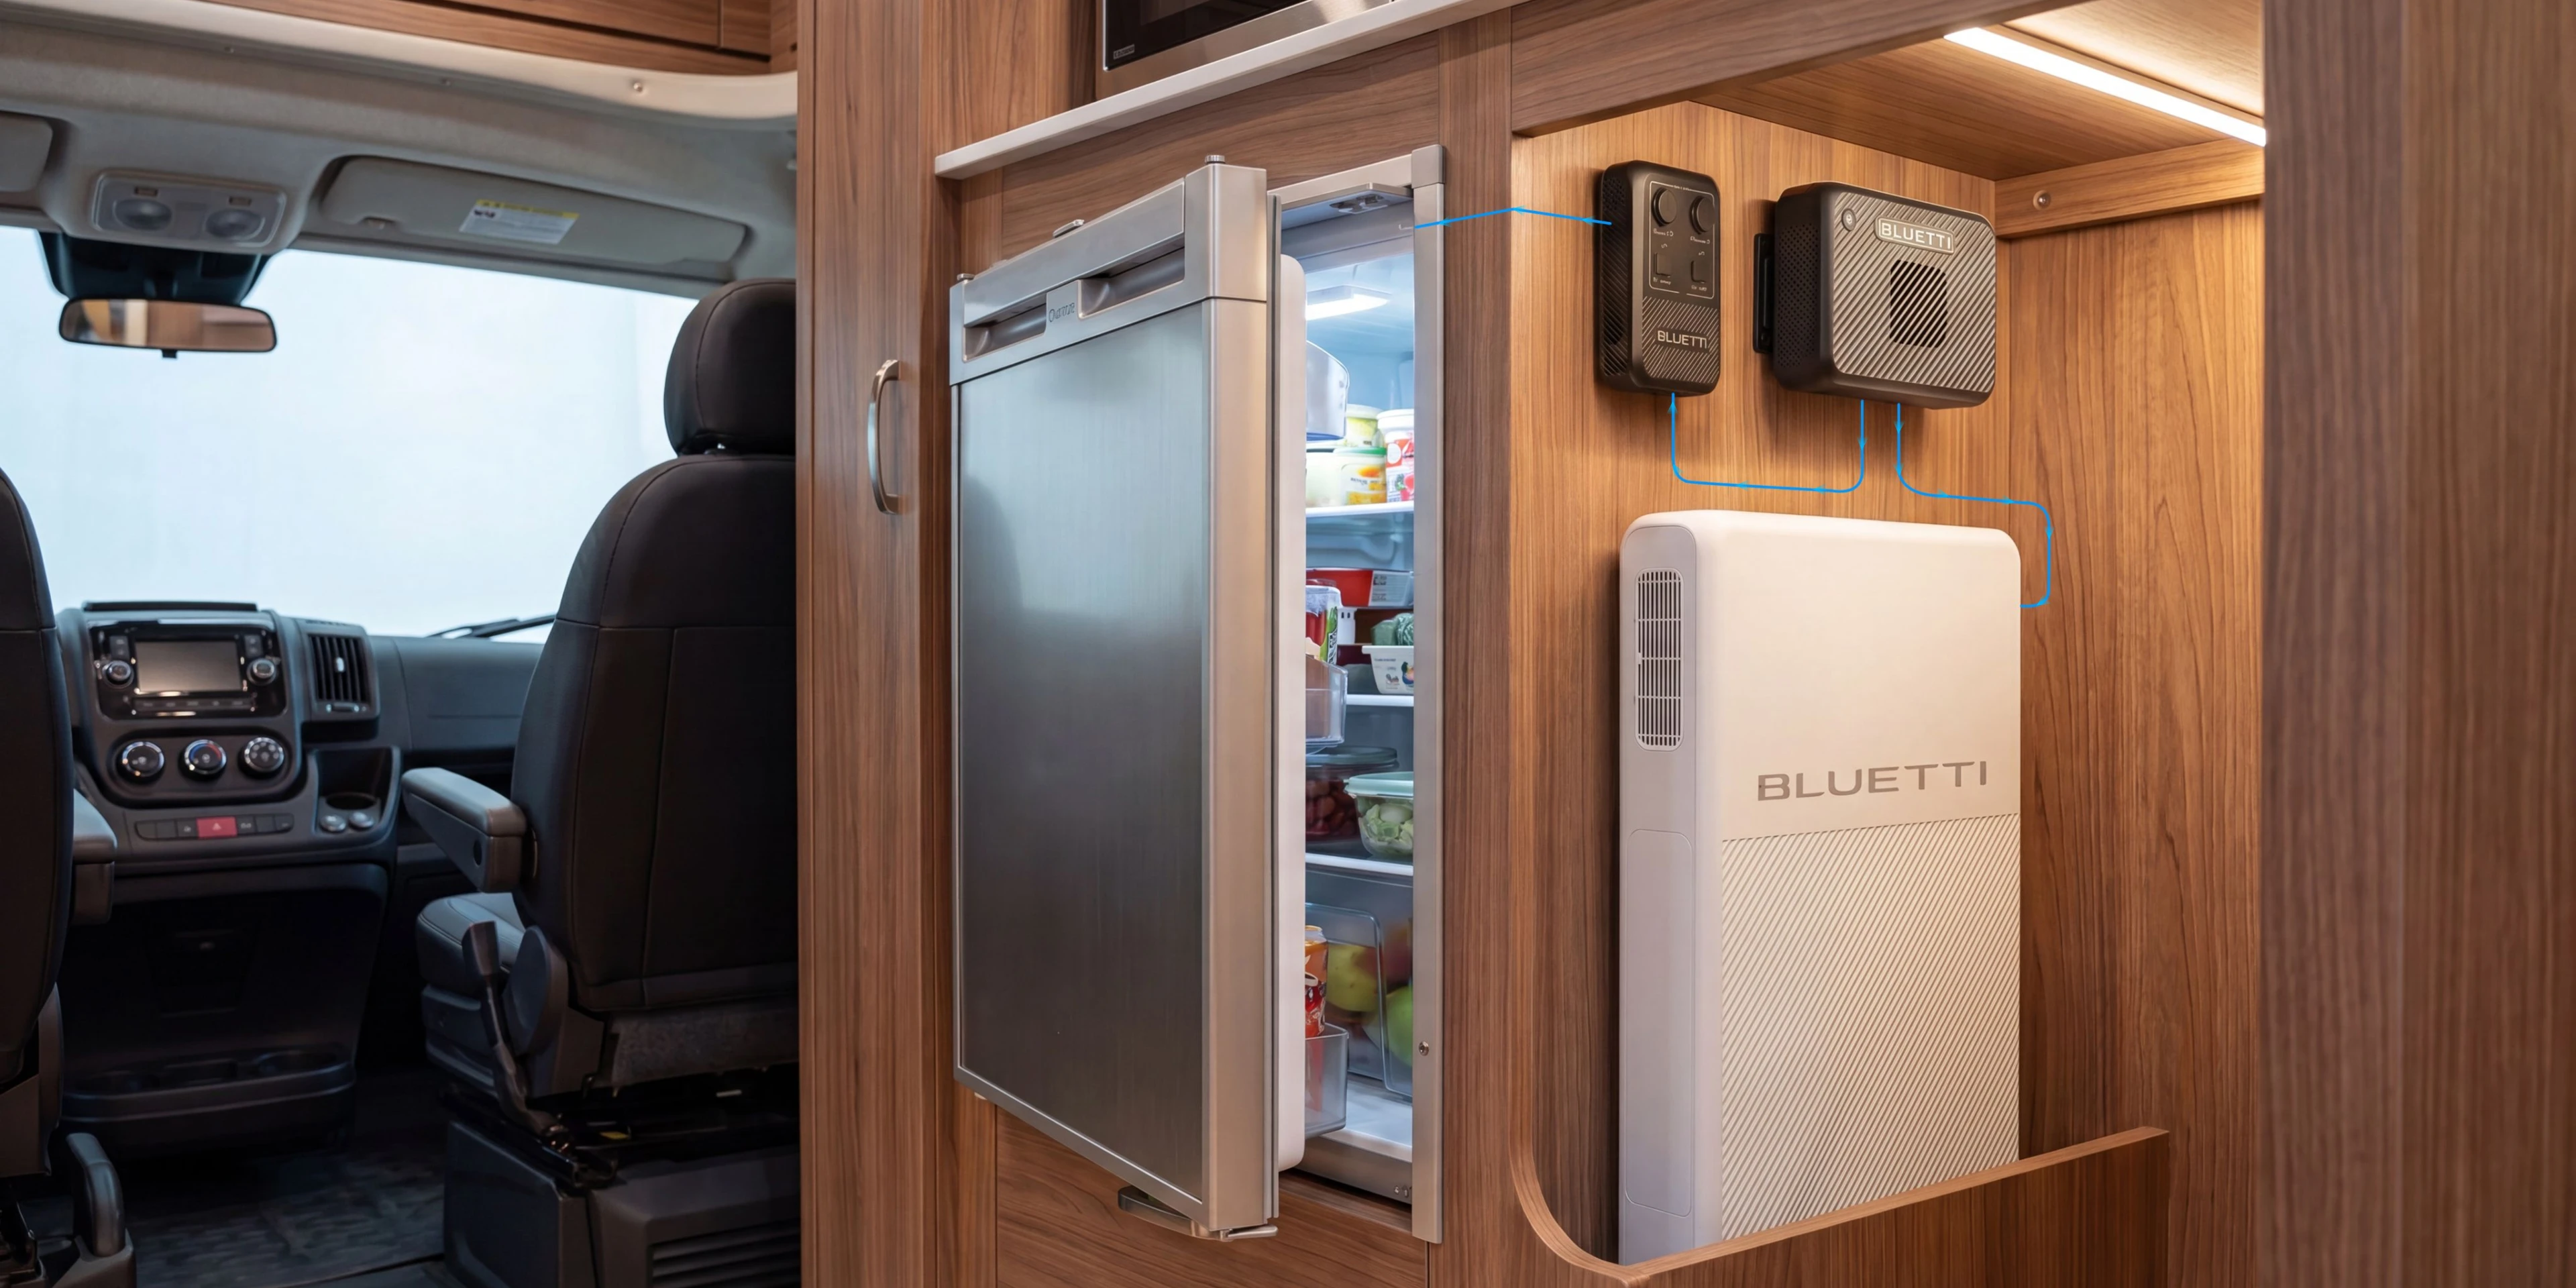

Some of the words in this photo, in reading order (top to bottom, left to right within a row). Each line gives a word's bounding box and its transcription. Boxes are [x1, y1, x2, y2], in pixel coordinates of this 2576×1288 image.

[1881, 222, 1951, 250] BLUETTI
[1657, 330, 1707, 349] BLUETTI
[1758, 761, 1987, 801] BLUETTI
